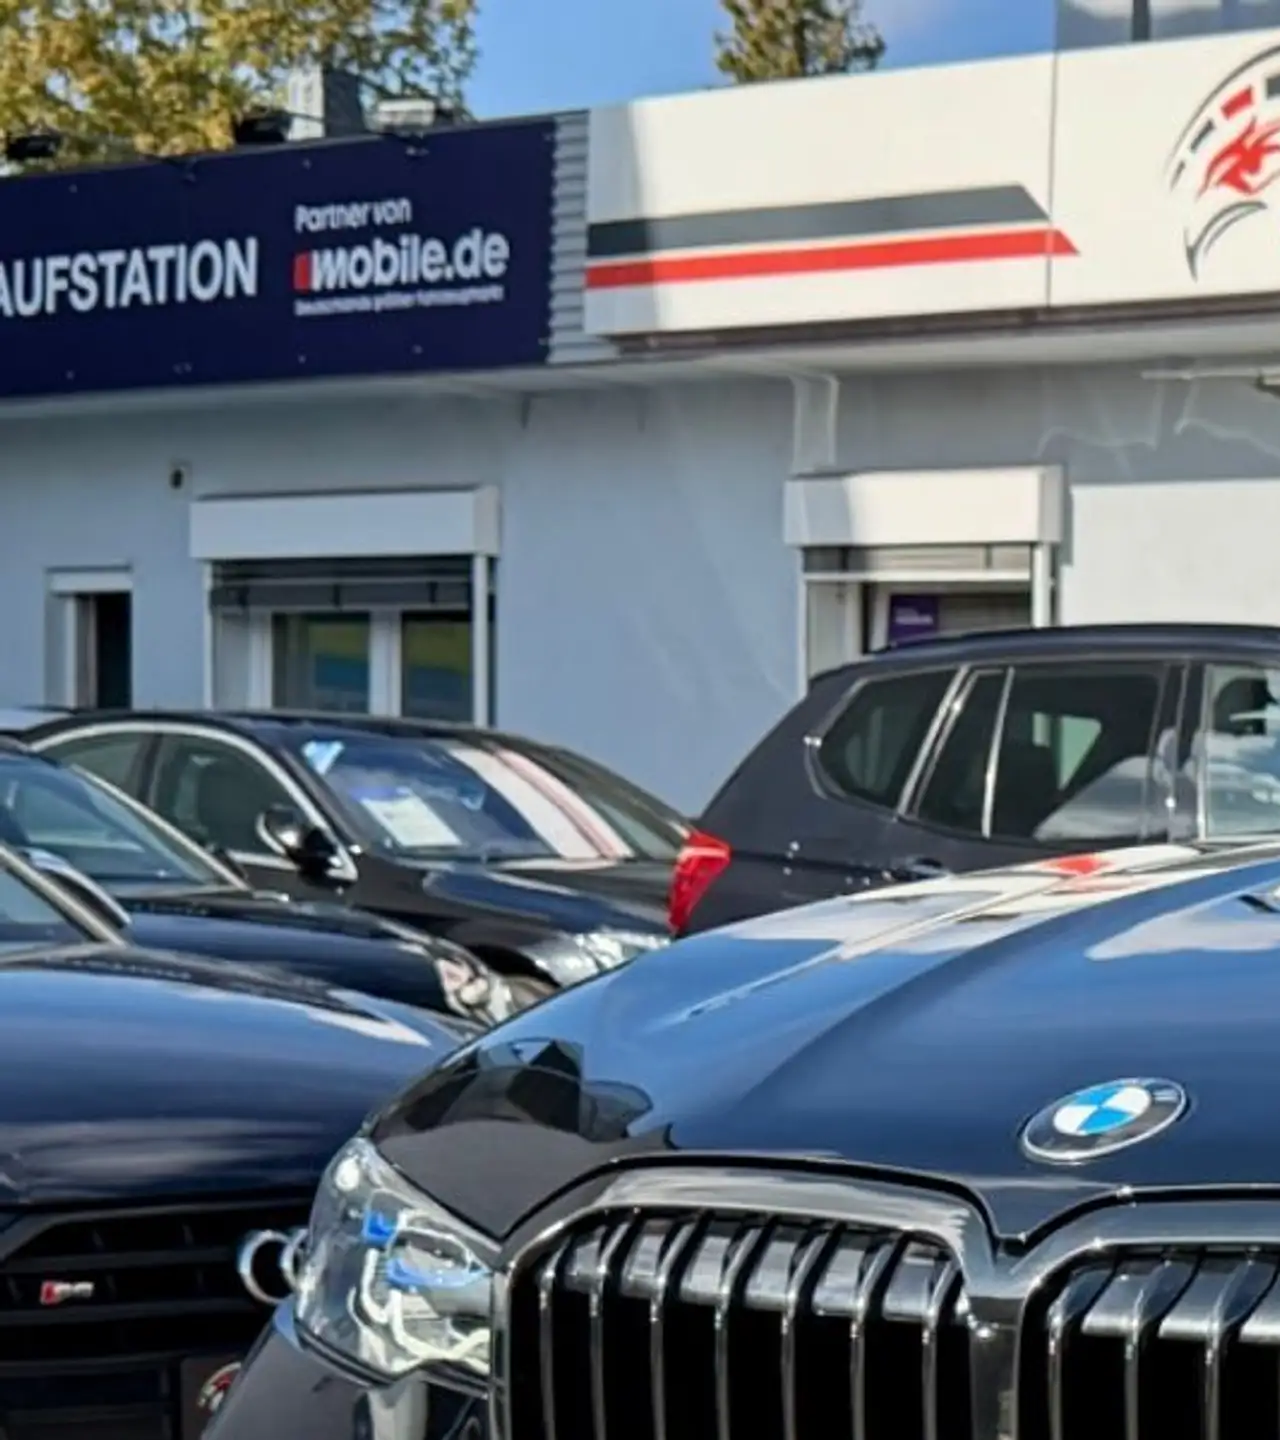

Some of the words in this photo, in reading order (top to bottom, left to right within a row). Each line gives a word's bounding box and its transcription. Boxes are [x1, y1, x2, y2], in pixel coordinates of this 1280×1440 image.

[294, 203, 369, 232] Partner
[372, 198, 411, 225] von
[310, 228, 510, 291] mobile.de
